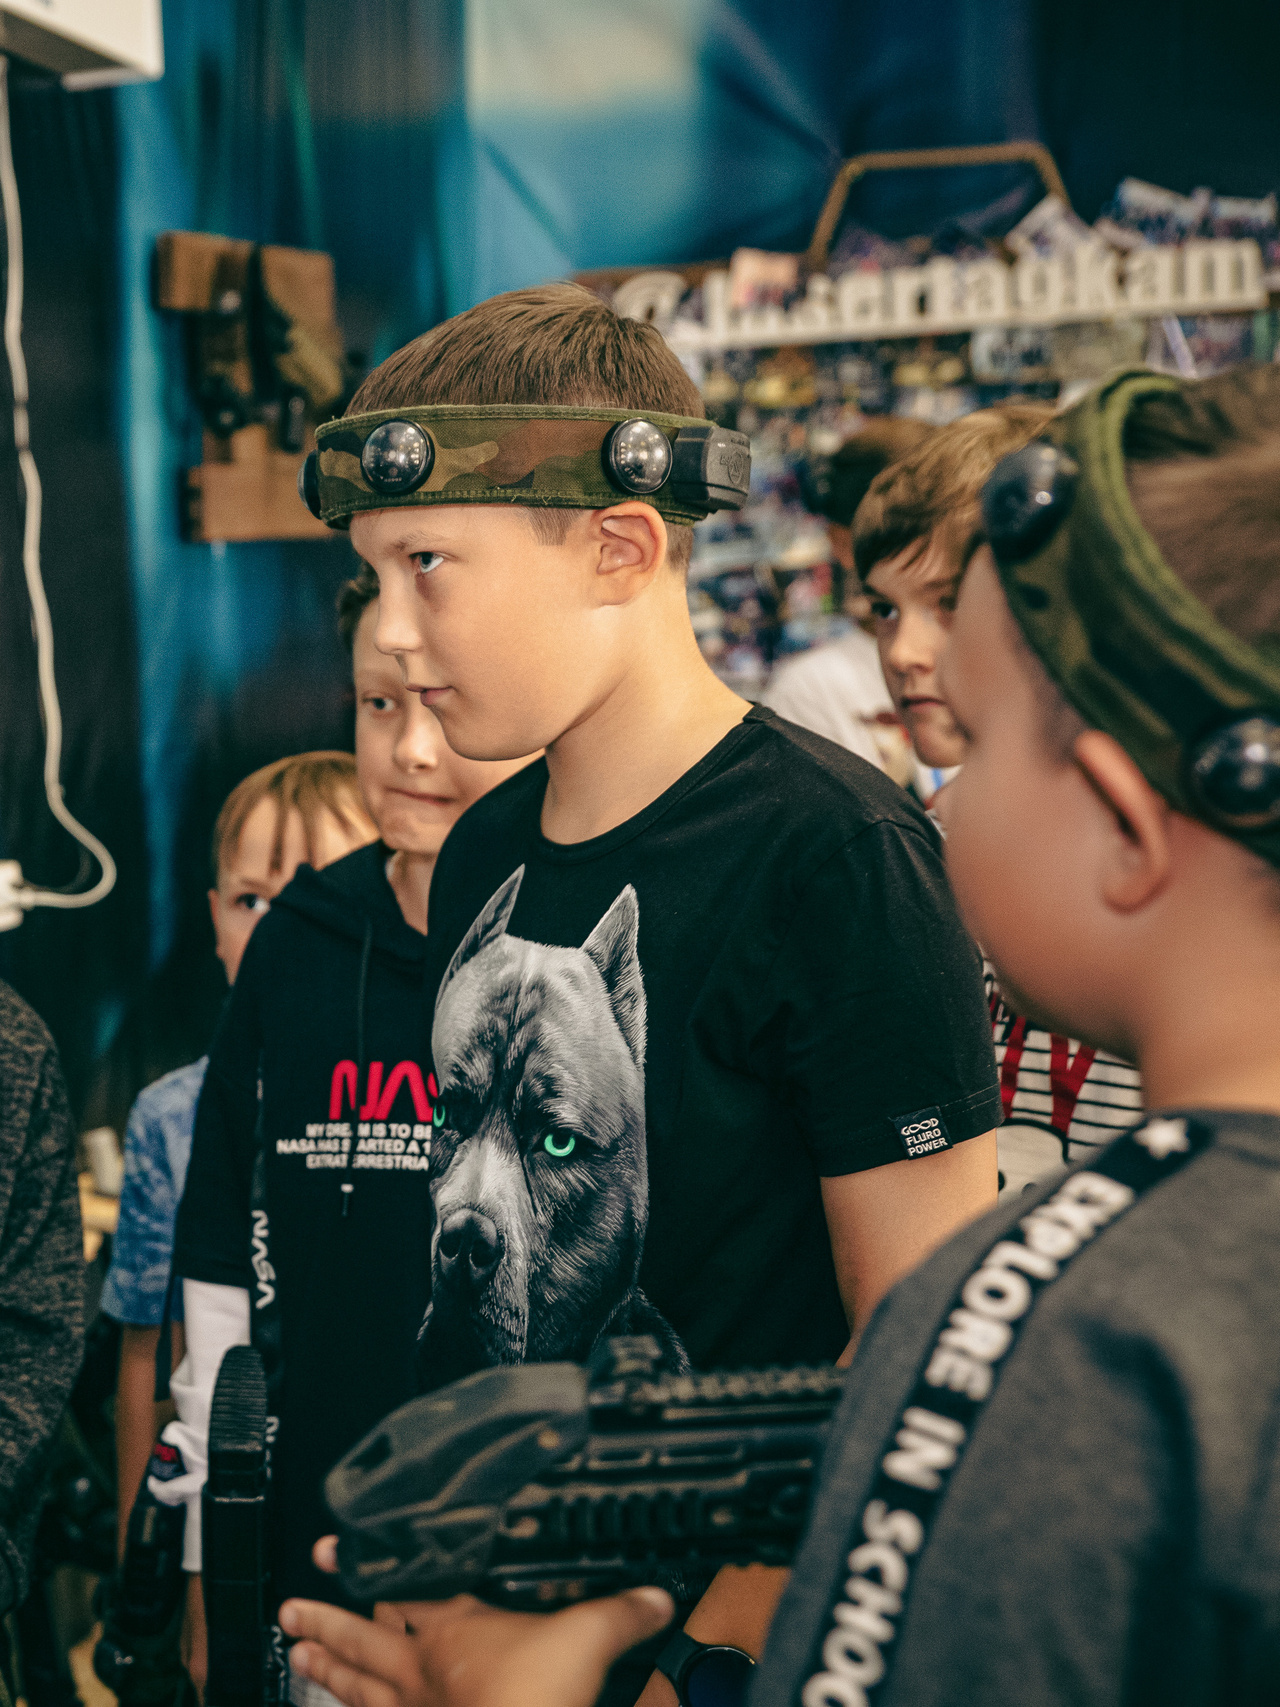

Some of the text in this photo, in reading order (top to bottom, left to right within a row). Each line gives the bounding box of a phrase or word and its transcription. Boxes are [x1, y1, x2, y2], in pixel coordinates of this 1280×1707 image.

[325, 1122, 371, 1138] DREM
[372, 1122, 387, 1138] IS
[388, 1123, 411, 1139] TO
[901, 1117, 939, 1136] GOOD
[276, 1138, 317, 1154] NASA
[341, 1138, 406, 1154] SARTED
[905, 1128, 941, 1146] FLURO
[907, 1137, 948, 1157] POWER
[251, 1210, 275, 1308] NASA
[926, 1171, 1136, 1400] EXPLORE
[883, 1406, 966, 1491] IN
